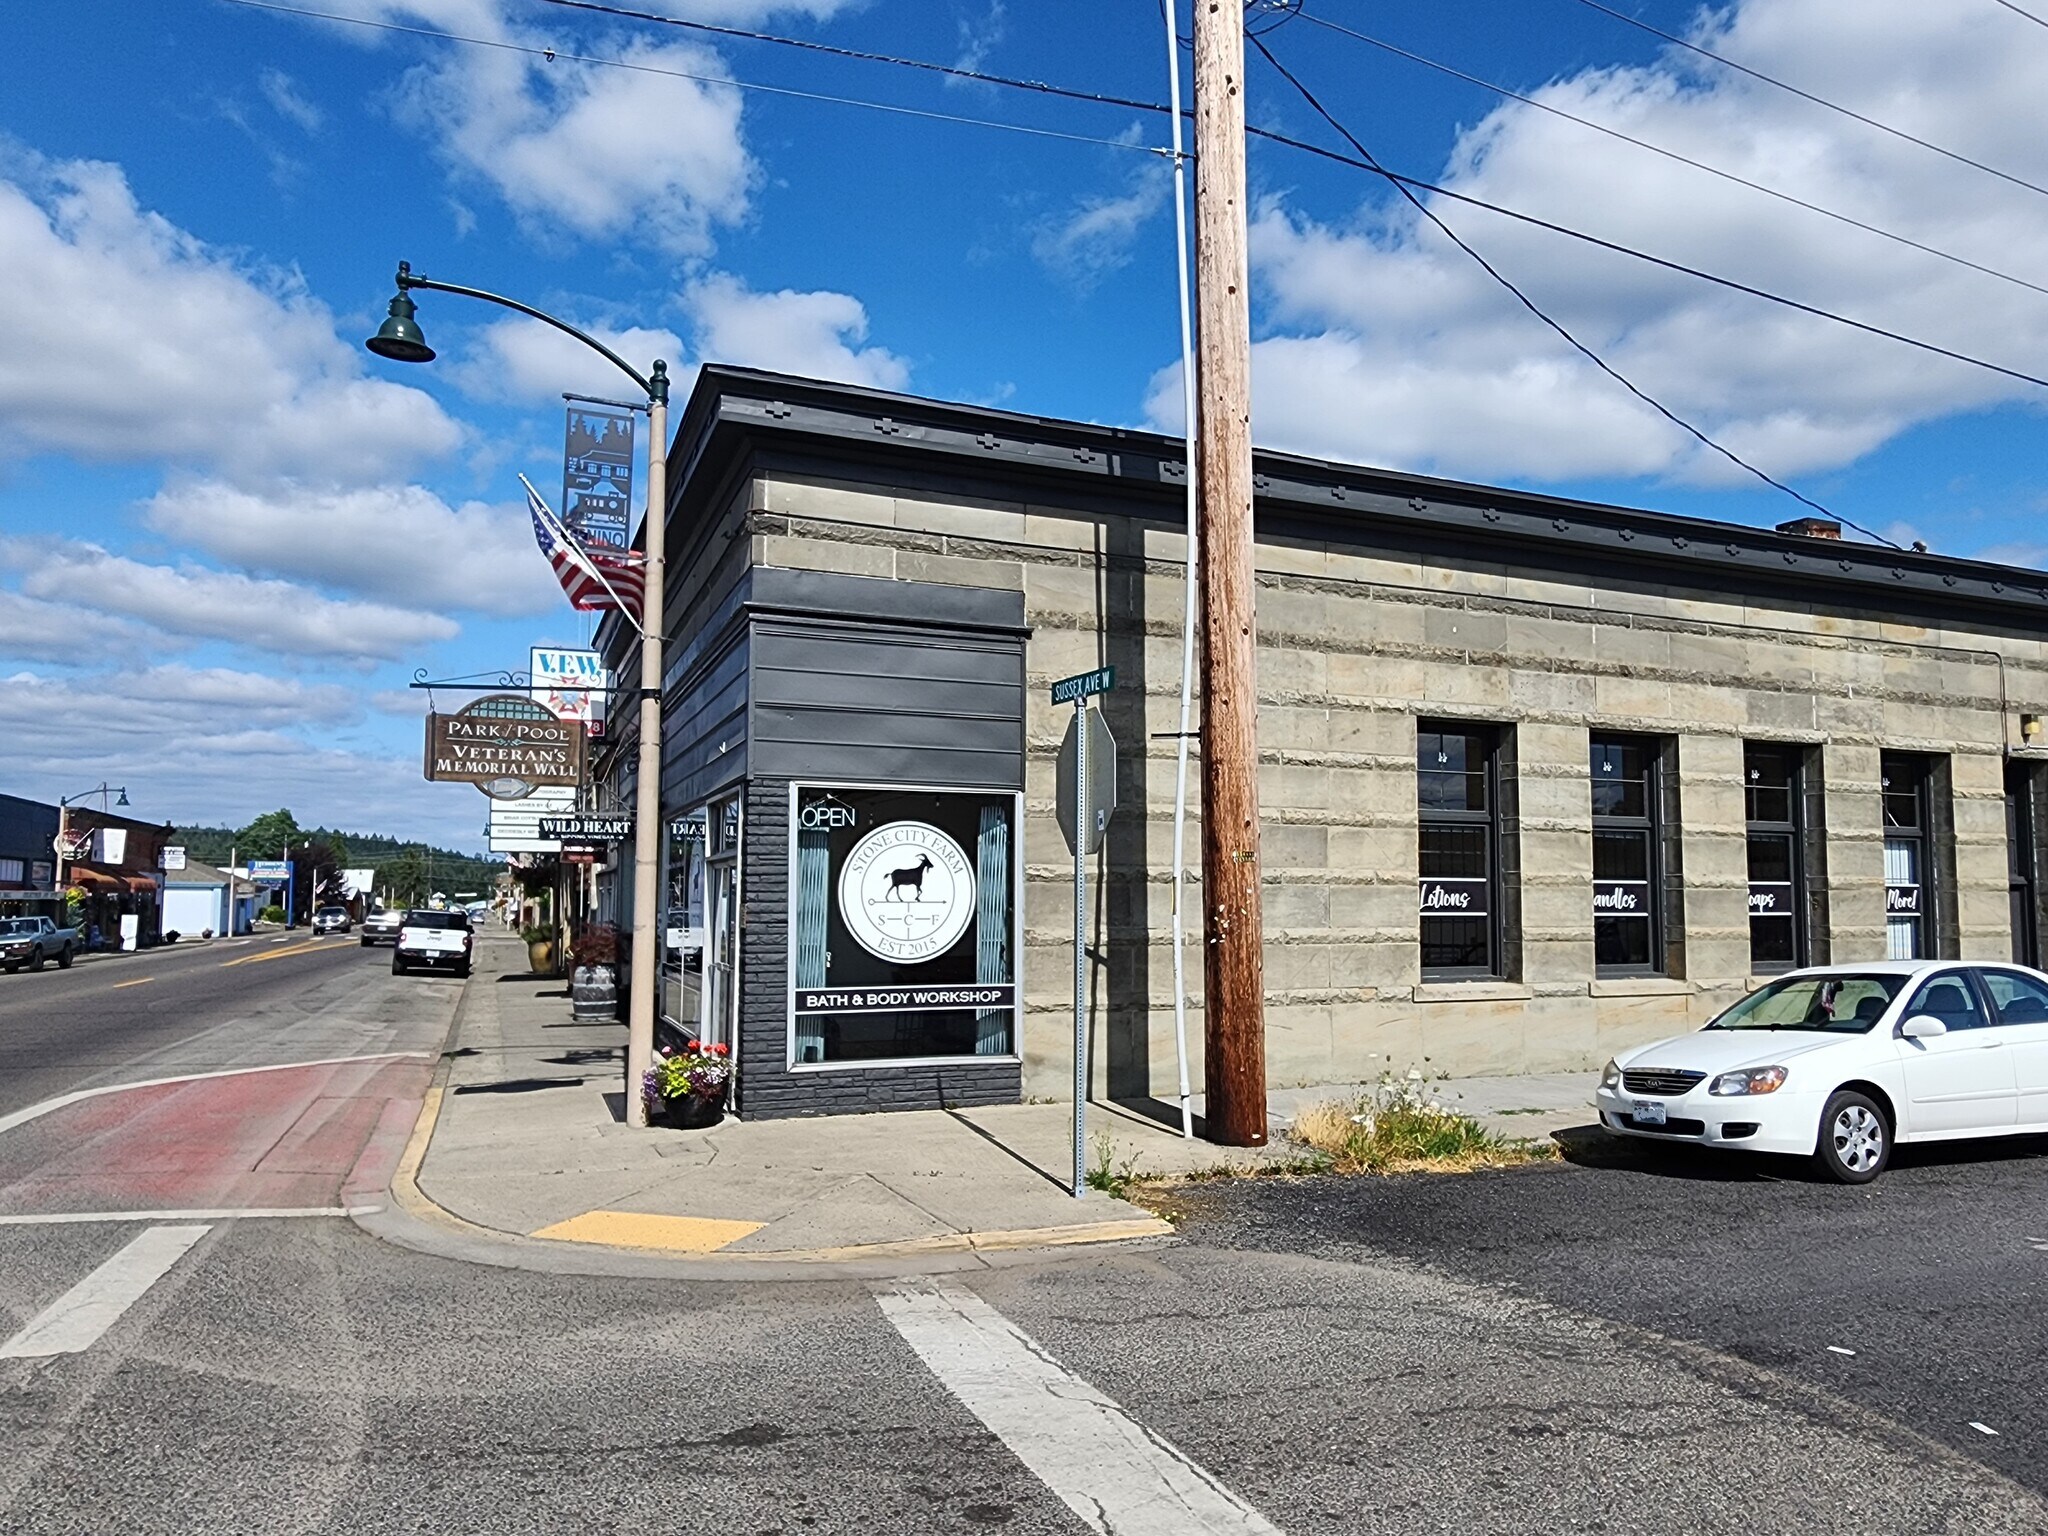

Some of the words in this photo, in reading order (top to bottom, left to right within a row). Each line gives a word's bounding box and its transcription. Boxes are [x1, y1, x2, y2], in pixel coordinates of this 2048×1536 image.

[587, 529, 624, 548] NINO
[538, 653, 602, 676] V.F.W.
[1055, 678, 1083, 701] SUSSEX
[1084, 674, 1100, 694] AVE
[1102, 670, 1110, 688] W
[448, 721, 501, 738] PARK
[517, 725, 570, 741] POOL
[452, 745, 567, 763] VETERAN'S
[436, 758, 530, 776] MEMORIAL
[534, 762, 578, 777] WALL
[542, 820, 581, 833] WILD
[583, 821, 632, 834] HEART
[801, 807, 856, 827] OPEN
[852, 834, 893, 875] STONE
[894, 829, 931, 844] CITY
[931, 837, 964, 875] FARM
[1419, 884, 1471, 910] Lotions
[1593, 887, 1638, 910] andles
[1748, 892, 1776, 914] oaps
[1887, 889, 1918, 910] More!
[877, 937, 906, 955] EST
[908, 937, 938, 955] 2015
[806, 994, 848, 1008] BATH
[852, 993, 864, 1006] &
[866, 993, 910, 1006] BODY
[912, 990, 1002, 1005] WORKSHOP
